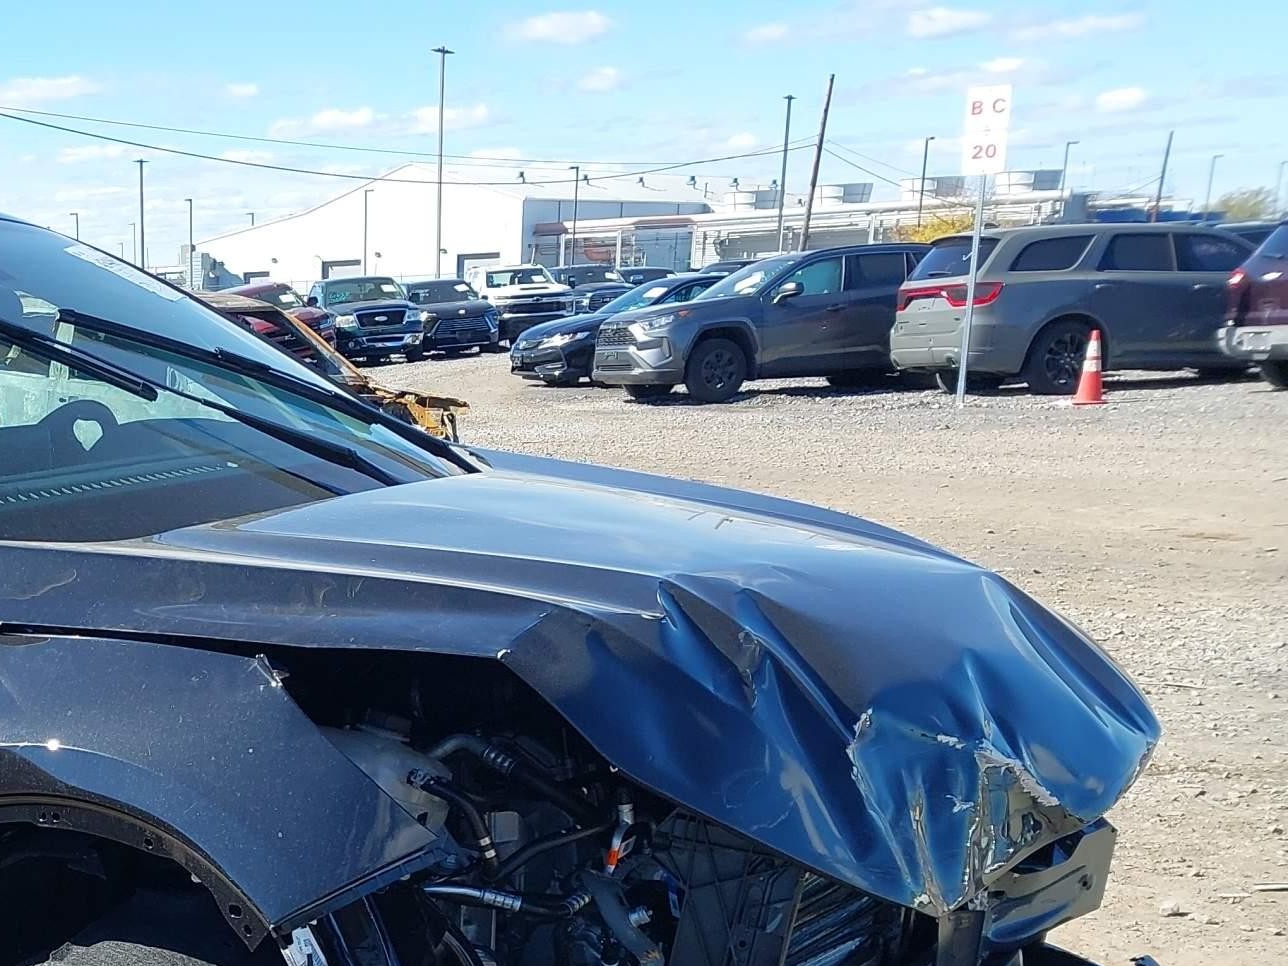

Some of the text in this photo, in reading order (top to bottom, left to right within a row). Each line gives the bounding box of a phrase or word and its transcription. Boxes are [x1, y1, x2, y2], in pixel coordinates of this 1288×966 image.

[971, 98, 1006, 115] B C
[971, 143, 997, 160] 20
